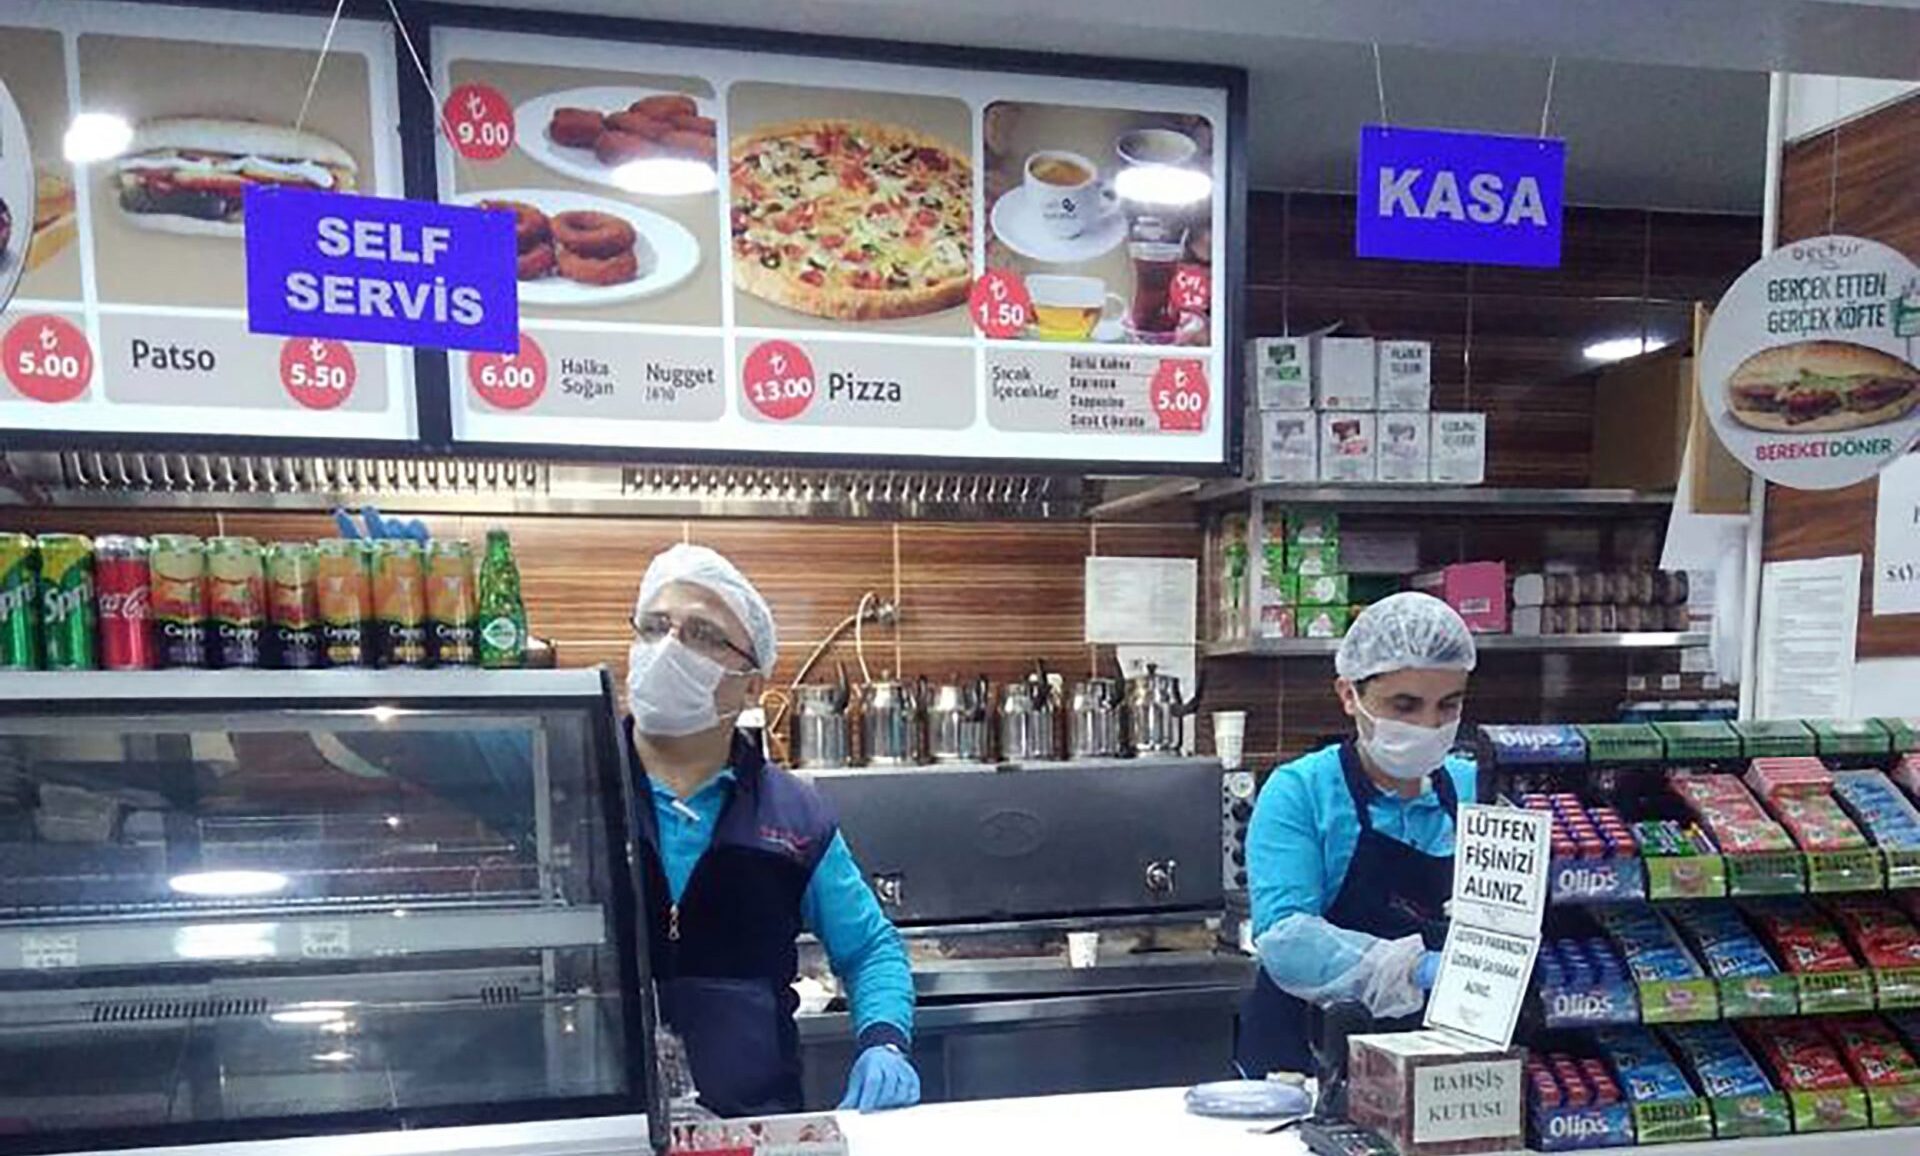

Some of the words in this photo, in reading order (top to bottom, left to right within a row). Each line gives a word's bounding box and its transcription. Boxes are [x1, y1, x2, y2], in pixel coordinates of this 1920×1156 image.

[458, 121, 510, 147] 9.00
[1378, 166, 1548, 226] KASA
[317, 216, 451, 265] SELF
[285, 271, 484, 326] SERVİS
[1767, 276, 1831, 306] GERÇEK
[1836, 272, 1887, 299] ETTEN
[979, 302, 1025, 327] 1.50
[1768, 308, 1830, 337] GERÇEK
[1834, 300, 1886, 331] KÖFTE
[18, 351, 80, 380] 5.00
[131, 339, 217, 372] Patso
[561, 358, 610, 377] Halka
[290, 362, 347, 390] 5.50
[480, 364, 536, 390] 6.00
[561, 378, 614, 399] Soğan
[646, 362, 715, 390] Nugget
[752, 376, 814, 404] 13.00
[829, 372, 902, 404] Pizza
[1158, 389, 1201, 410] 5.00
[1466, 811, 1537, 843] LÜTFEN
[1465, 841, 1535, 875] FİŞİNİZİ
[1464, 875, 1527, 906] ALINIZ.
[1558, 867, 1619, 898] Olips
[1554, 994, 1613, 1018] Olips
[1429, 1101, 1502, 1122] KUTUSU
[1550, 1115, 1610, 1143] Olips
